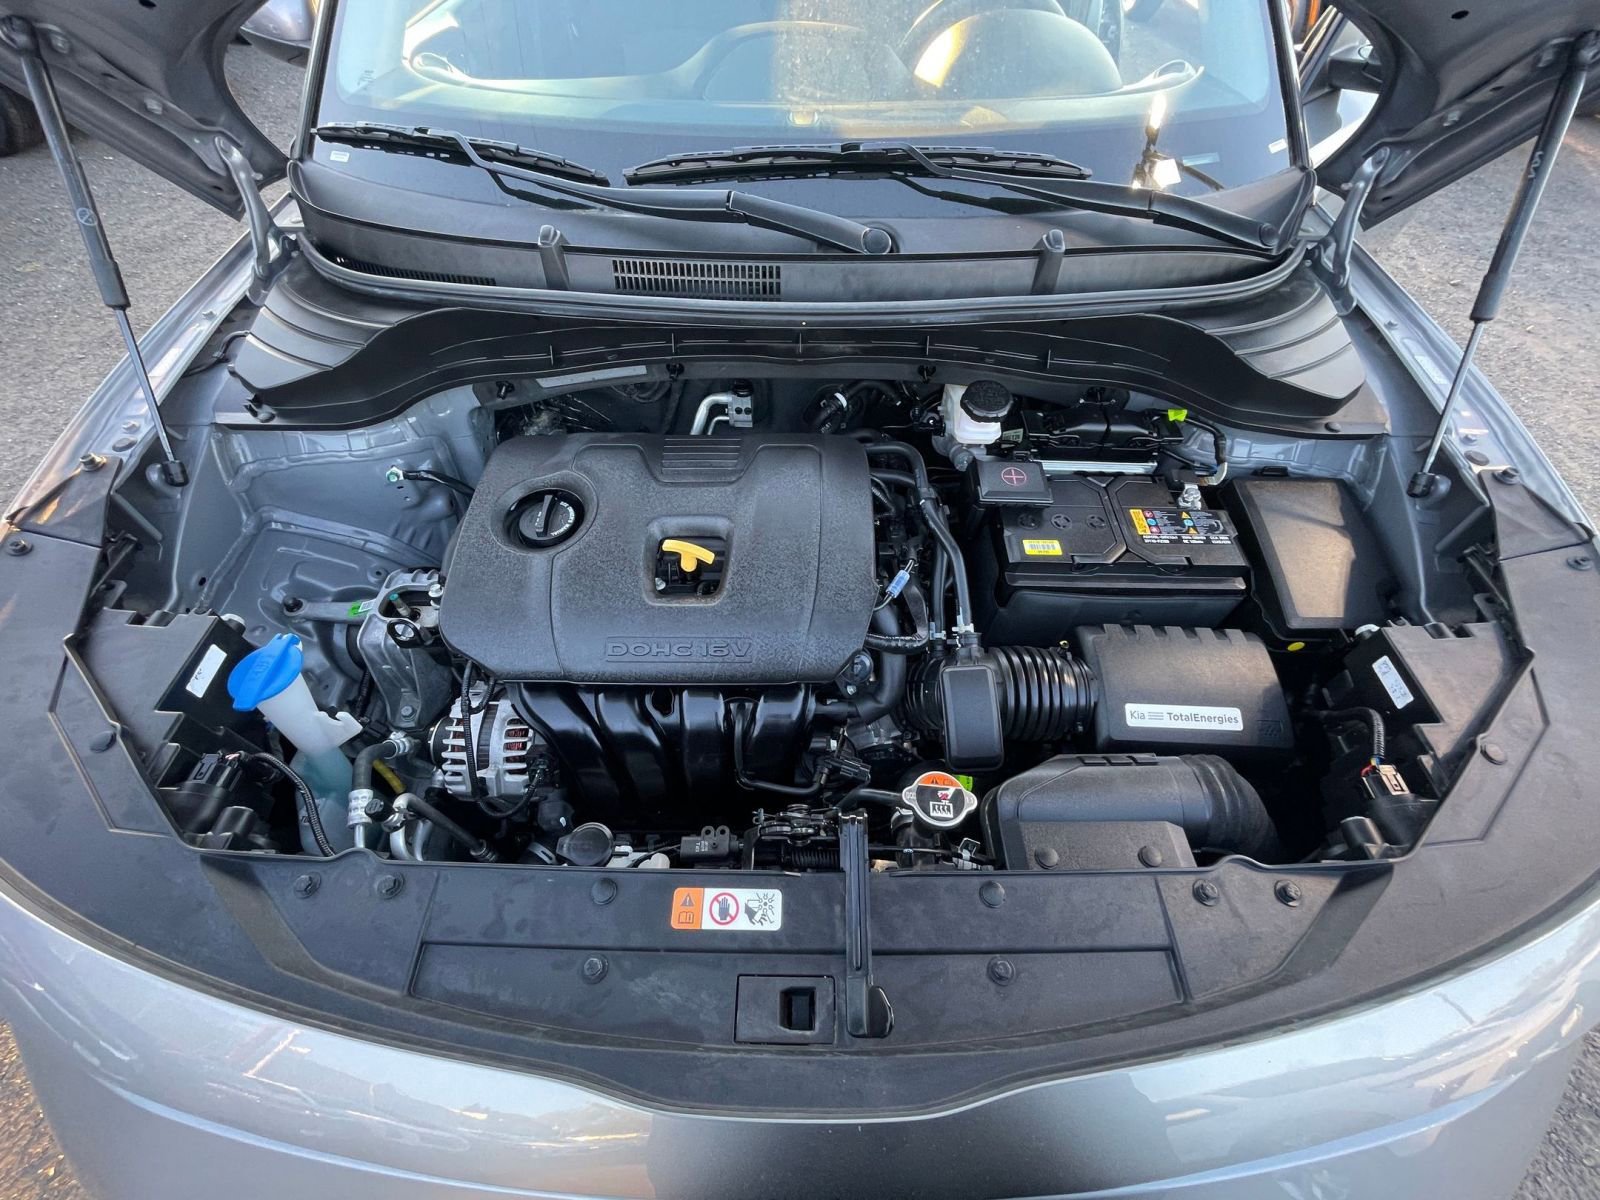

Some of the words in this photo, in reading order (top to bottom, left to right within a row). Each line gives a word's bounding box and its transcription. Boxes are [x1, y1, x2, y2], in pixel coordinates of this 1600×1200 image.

[607, 642, 693, 657] DOHC
[701, 641, 751, 658] 16V
[1130, 710, 1146, 720] Kia
[1166, 712, 1239, 725] TotalEnergies
